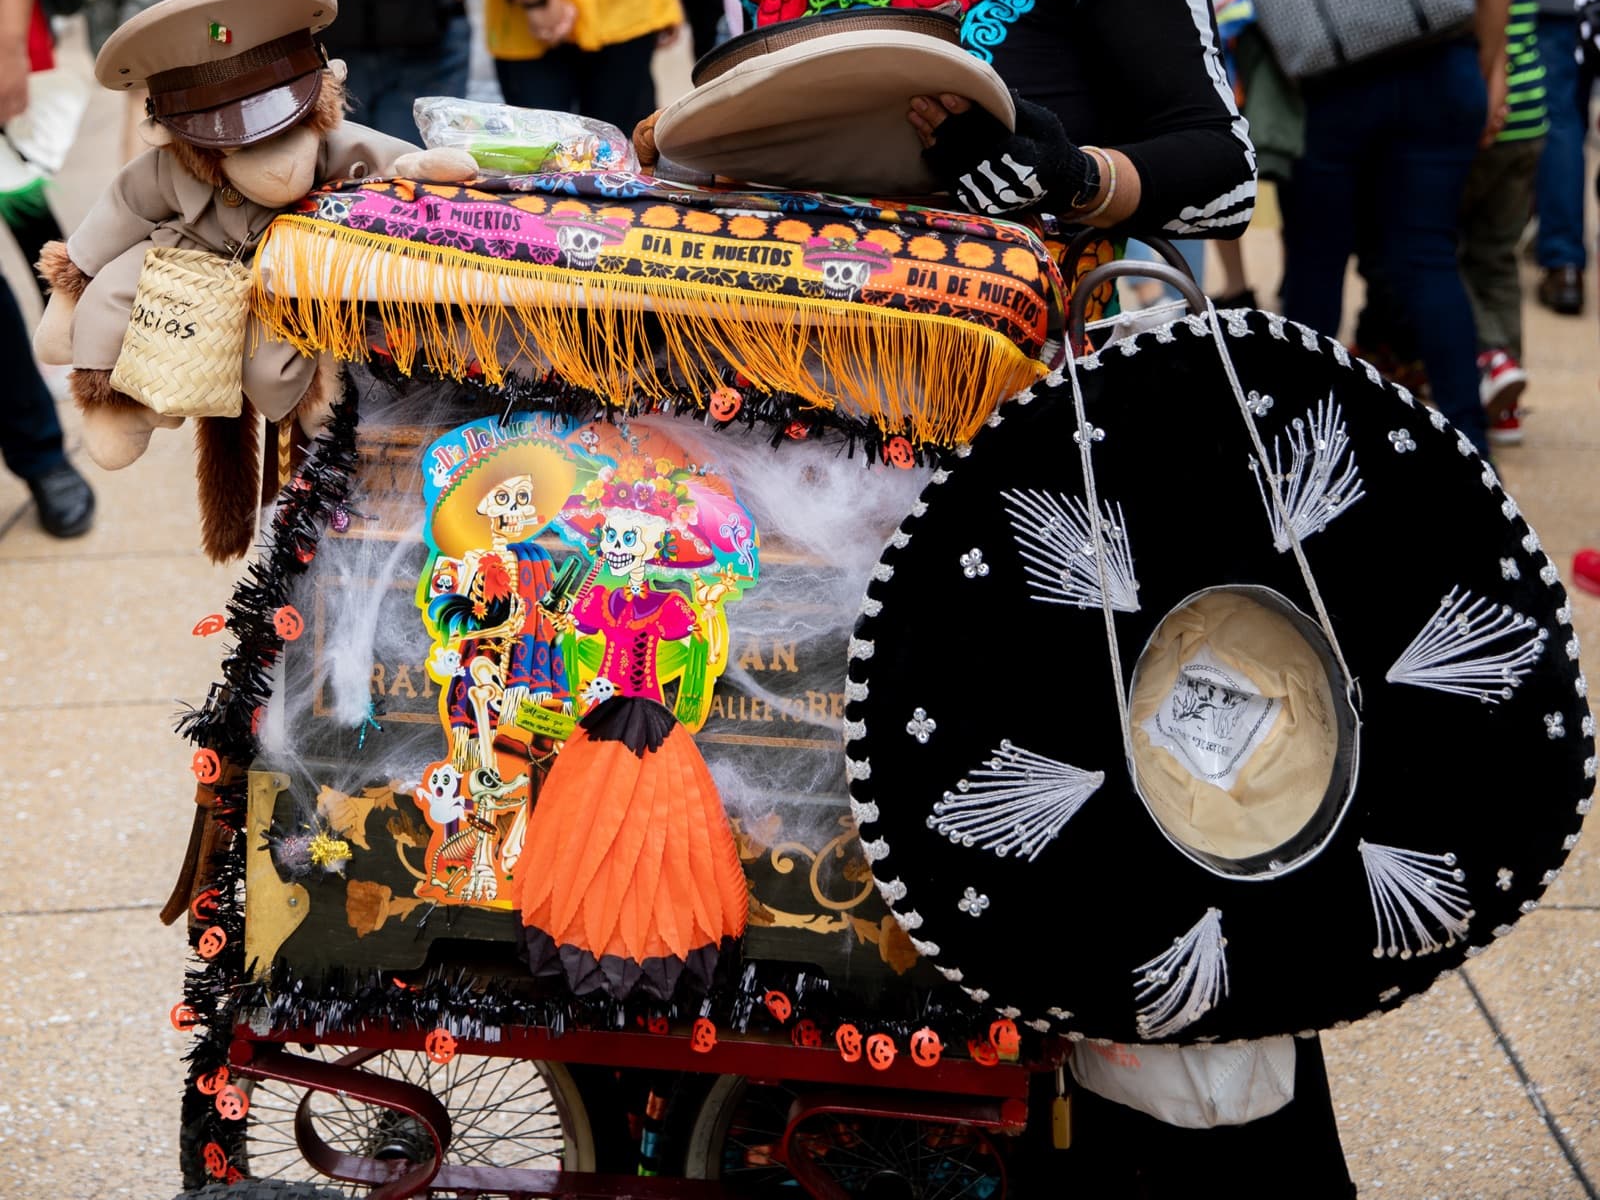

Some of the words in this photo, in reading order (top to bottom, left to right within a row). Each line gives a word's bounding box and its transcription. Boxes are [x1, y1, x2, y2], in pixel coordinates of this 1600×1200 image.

[425, 202, 442, 223] DE
[450, 207, 522, 232] MUERTOS
[681, 240, 706, 260] DE
[711, 244, 793, 267] MUERTOS
[946, 274, 971, 297] DE
[977, 280, 1042, 328] MUERTOS
[132, 303, 198, 339] acias
[369, 663, 434, 698] RAT
[737, 637, 799, 673] AN
[806, 689, 846, 722] BE
